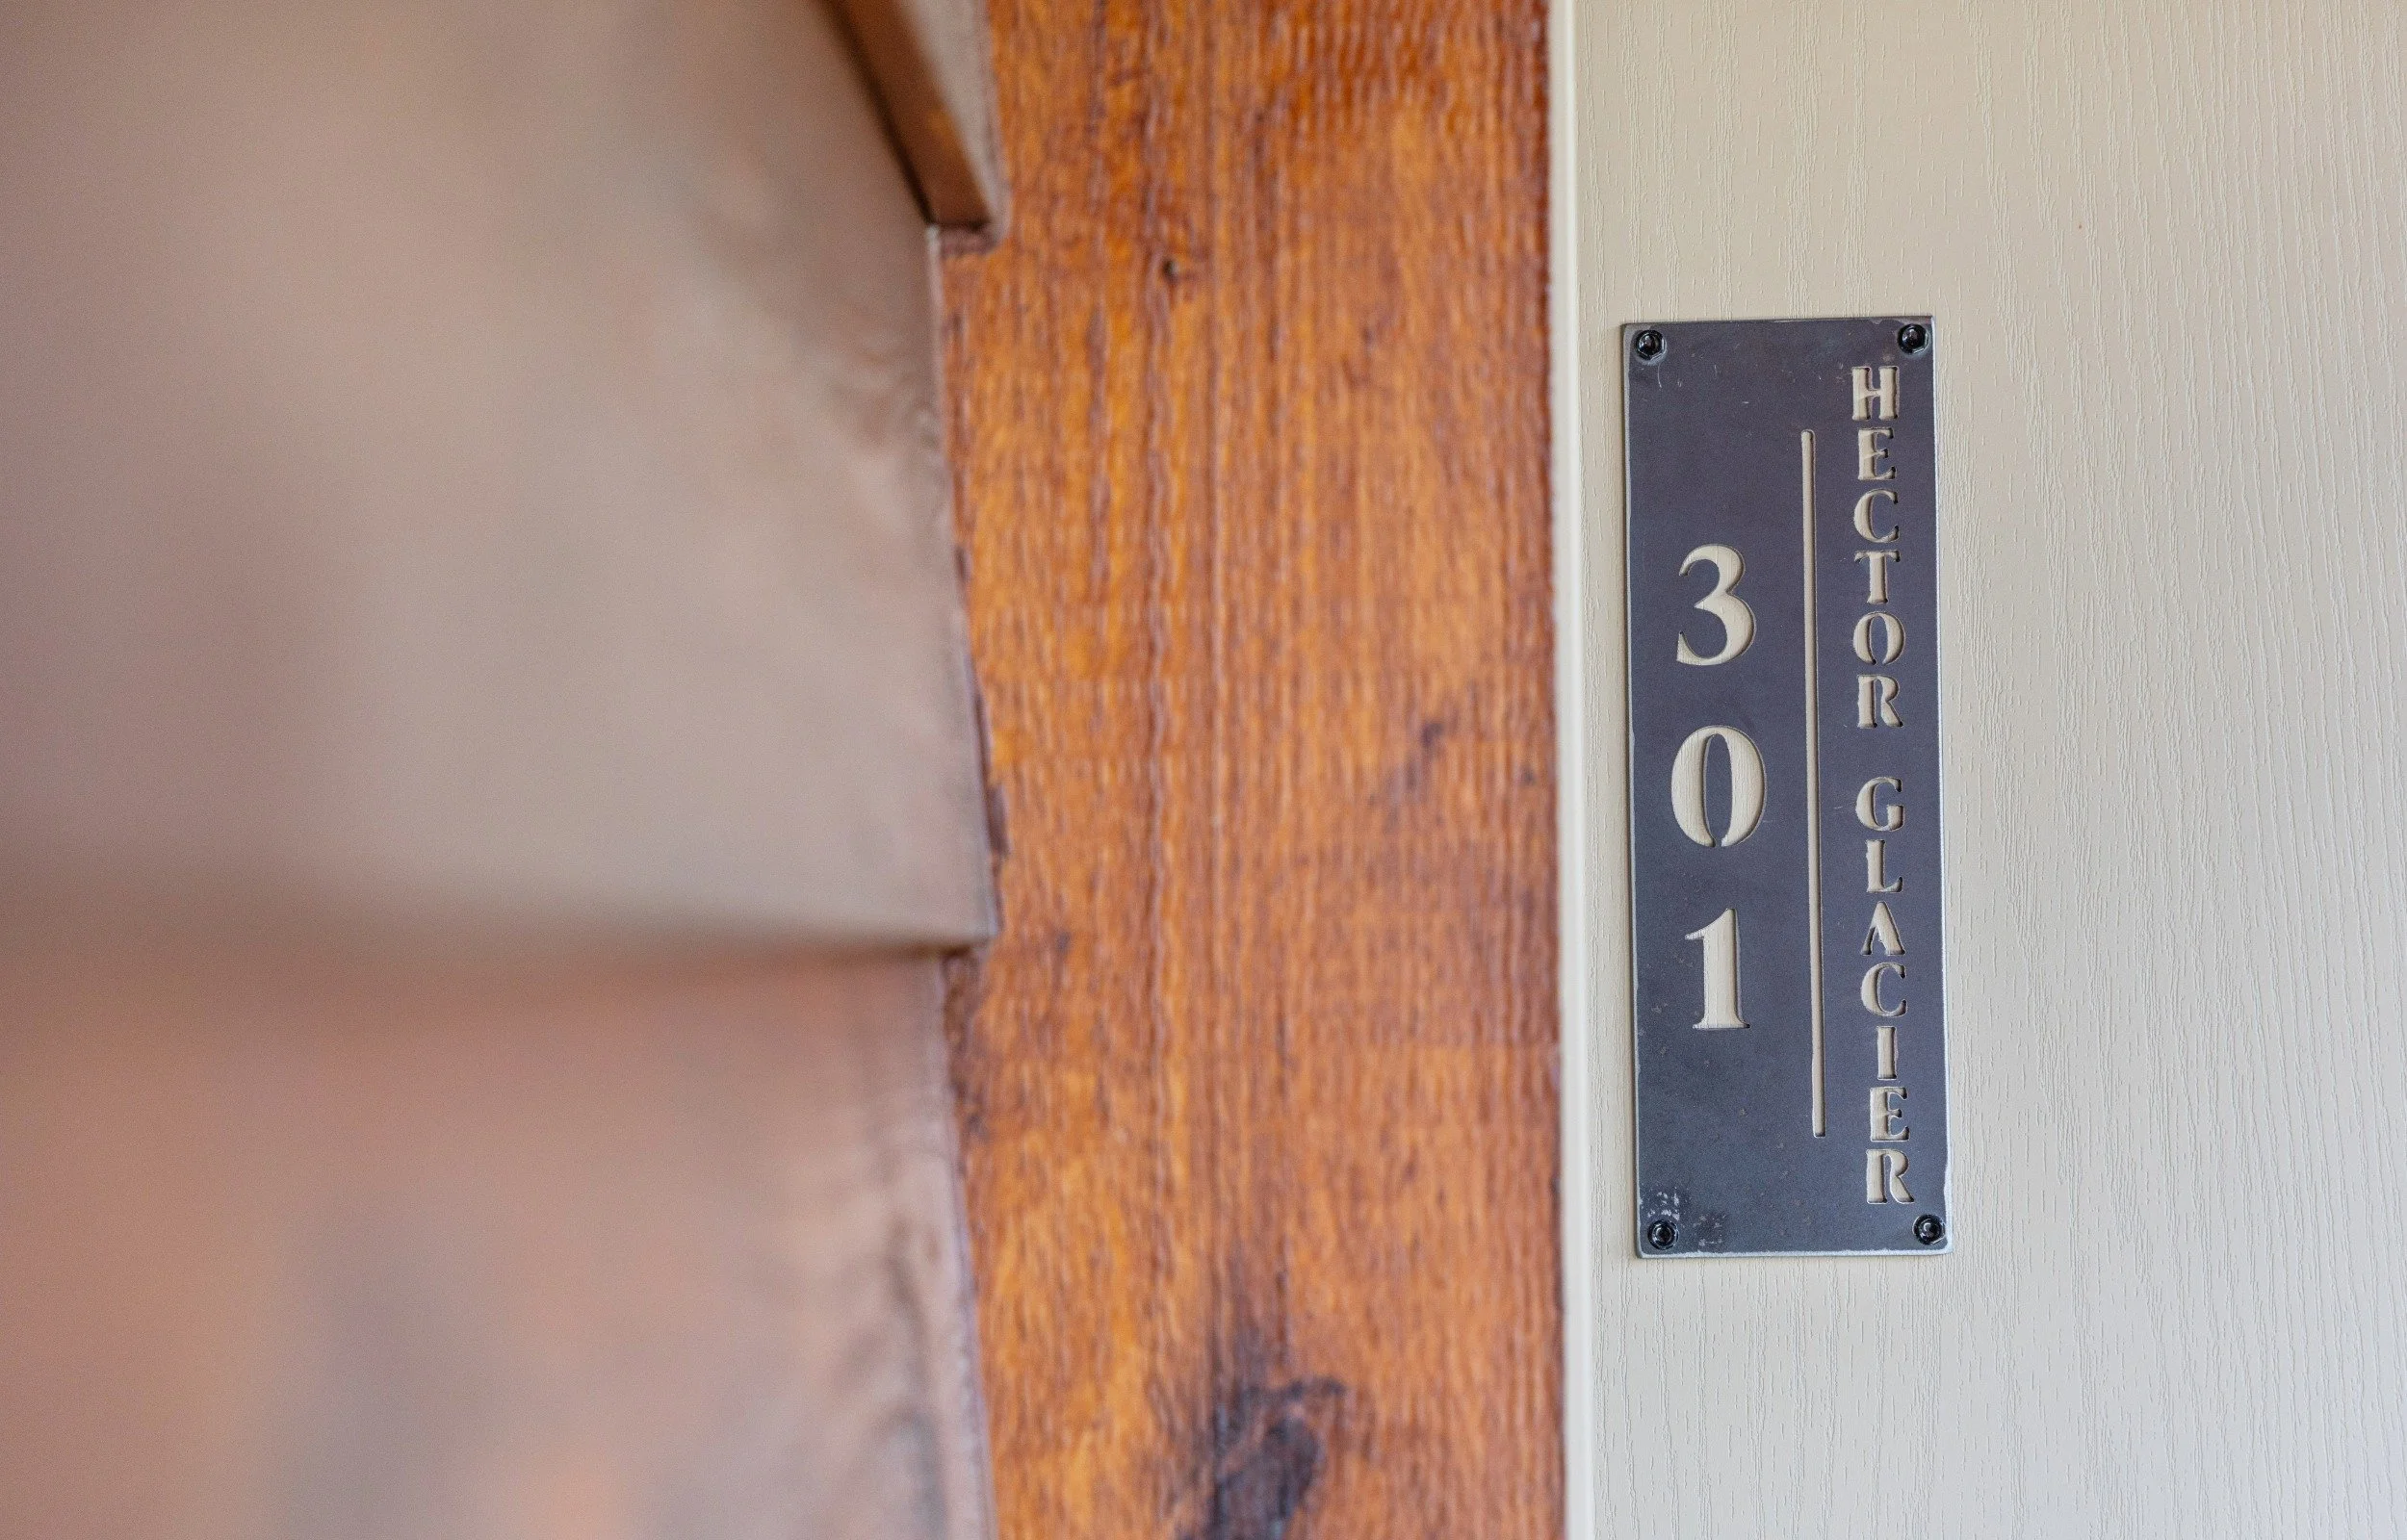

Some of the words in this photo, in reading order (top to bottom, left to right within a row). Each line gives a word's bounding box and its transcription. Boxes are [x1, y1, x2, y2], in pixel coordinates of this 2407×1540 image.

[1851, 365, 1906, 729] HECTOR
[1670, 543, 1768, 1030] 301
[1855, 776, 1915, 1204] GLACIER
